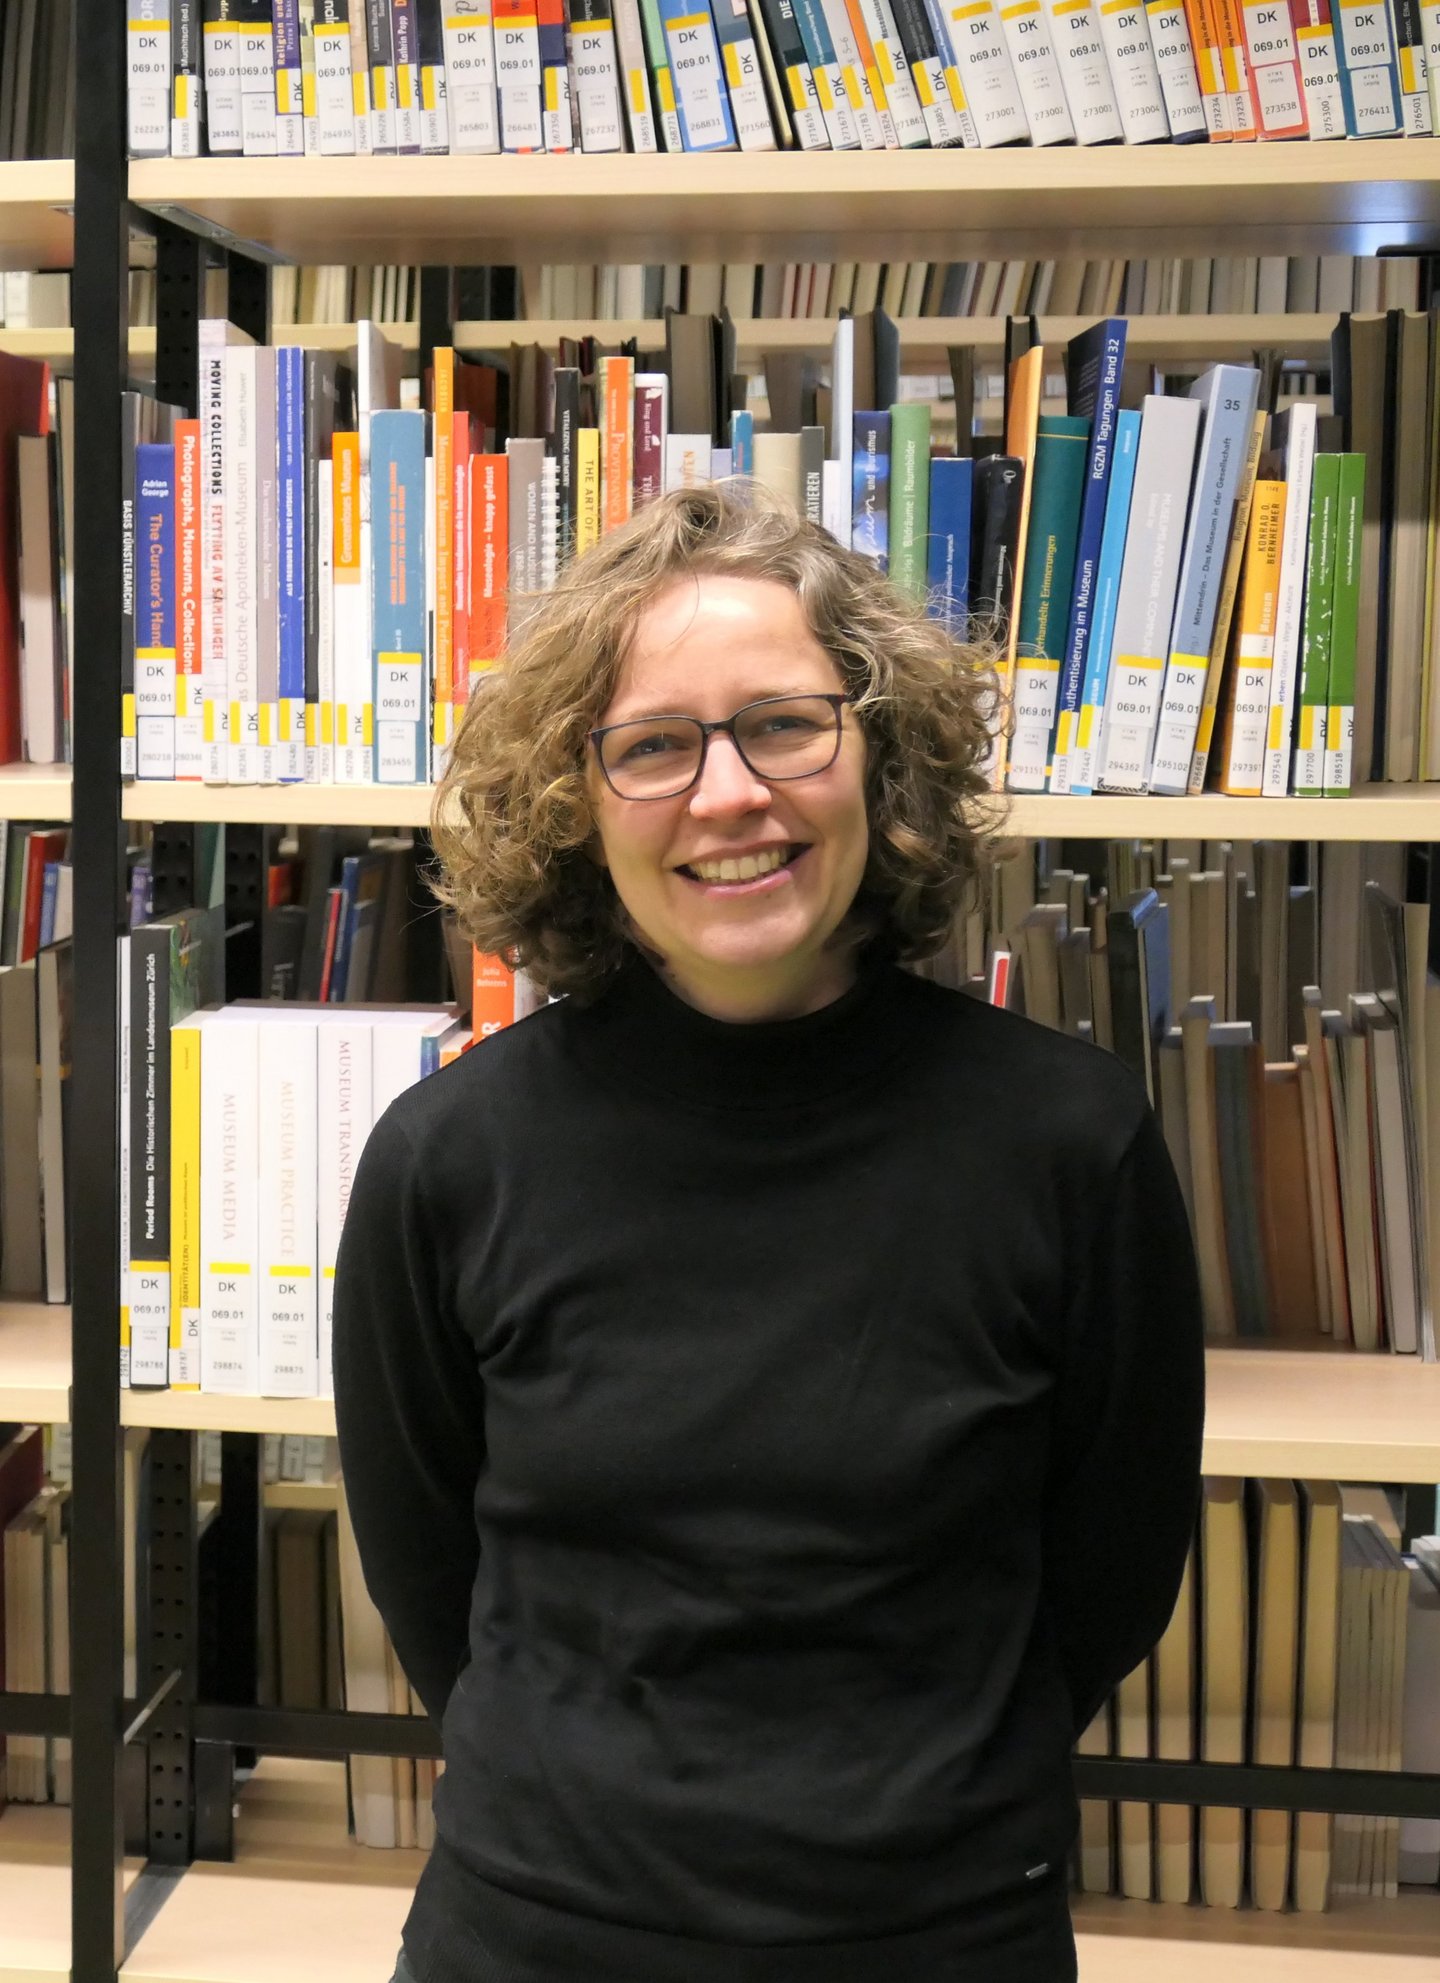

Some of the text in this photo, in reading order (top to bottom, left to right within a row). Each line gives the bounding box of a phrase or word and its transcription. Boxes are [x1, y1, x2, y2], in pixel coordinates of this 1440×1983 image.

[1070, 16, 1089, 29] DK
[1118, 15, 1137, 28] DK
[1160, 15, 1179, 29] DK
[1257, 11, 1277, 24] DK
[1355, 15, 1374, 27] DK
[970, 21, 989, 34] DK
[1018, 20, 1038, 33] DK
[139, 38, 157, 48] DK
[277, 22, 287, 65] Religion
[458, 33, 476, 43] DK
[506, 33, 524, 44] DK
[583, 39, 601, 49] DK
[679, 31, 698, 43] DK
[214, 40, 232, 50] DK
[247, 40, 265, 50] DK
[324, 42, 341, 52] DK
[1070, 43, 1101, 58] 069.01
[1117, 42, 1149, 57] 069.01
[1254, 39, 1289, 53] 069.01
[1308, 45, 1328, 58] DK
[1351, 43, 1386, 56] 069.01
[892, 51, 906, 70] DK
[970, 47, 1003, 63] 069.01
[1018, 46, 1050, 62] 069.01
[133, 64, 165, 72] 069.01
[453, 59, 486, 69] 069.01
[500, 60, 534, 70] 069.01
[676, 55, 711, 69] 069.01
[741, 54, 754, 74] DK
[578, 65, 611, 76] 069.01
[832, 77, 846, 96] DK
[931, 71, 946, 90] DK
[985, 107, 1016, 121] 273001
[1035, 106, 1064, 120] 273002
[1083, 104, 1112, 118] 273003
[1130, 105, 1160, 118] 273004
[1171, 105, 1202, 118] 273005
[1212, 97, 1223, 128] 273234
[1235, 96, 1247, 127] 273235
[1265, 102, 1297, 115] 273538
[1359, 106, 1390, 117] 276411
[1413, 97, 1424, 129] 276501
[1322, 100, 1333, 133] 275300
[643, 403, 652, 420] King
[1093, 338, 1119, 479] RGZM Tagungen Band 32
[1224, 399, 1240, 411] 35
[643, 421, 652, 434] and
[562, 410, 570, 487] VITALIZING MEMORY
[904, 440, 915, 492] Raumbilder
[142, 480, 167, 488] Adrian
[867, 475, 876, 491] und
[141, 488, 169, 497] George
[585, 460, 594, 532] THE ART OF
[211, 360, 222, 660] MOVING COLLECTIONS FLYTTING AV SAMLINGER
[527, 482, 536, 544] WOMEN AND
[149, 513, 162, 540] The
[438, 500, 448, 547] Museum
[902, 500, 914, 548] Bildräume
[235, 461, 248, 610] Apotheken-Museum
[1193, 437, 1231, 626] Mittendrin Das Museum in der Gesellschaft
[1257, 511, 1270, 553] KONRAD
[1267, 503, 1280, 564] BERNHEIMER
[122, 500, 133, 615] BASIS KÜNSTLERARCHIV
[181, 435, 195, 674] Photographs, Museums, Collections
[1041, 535, 1056, 598] Erinnerungen
[1077, 559, 1093, 608] Museum
[438, 595, 447, 617] and
[1259, 592, 1272, 633] Museum
[1074, 611, 1087, 624] im
[236, 616, 248, 683] Deutsche
[146, 666, 164, 676] DK
[390, 672, 408, 682] DK
[1029, 678, 1048, 690] DK
[1128, 675, 1147, 686] DK
[1176, 672, 1195, 685] DK
[1245, 676, 1264, 686] DK
[139, 694, 171, 702] 069.01
[382, 700, 415, 708] 069.01
[1019, 706, 1051, 717] 069.01
[1117, 702, 1151, 714] 069.01
[1165, 701, 1199, 714] 069.01
[247, 713, 258, 731] DK
[338, 1041, 350, 1113] MUSEUM
[145, 953, 156, 1239] Period Rooms Die Historischen Zimmer im Landesmuseum Zürich
[223, 1094, 236, 1240] MUSEUM MEDIA
[280, 1081, 295, 1257] MUSEUM PRACTICE
[141, 1279, 159, 1289] DK
[218, 1282, 236, 1292] DK
[278, 1284, 297, 1294] DK
[134, 1305, 166, 1314] 069.01
[212, 1310, 244, 1319] 069.01
[272, 1312, 304, 1321] 069.01
[188, 1319, 198, 1336] DK
